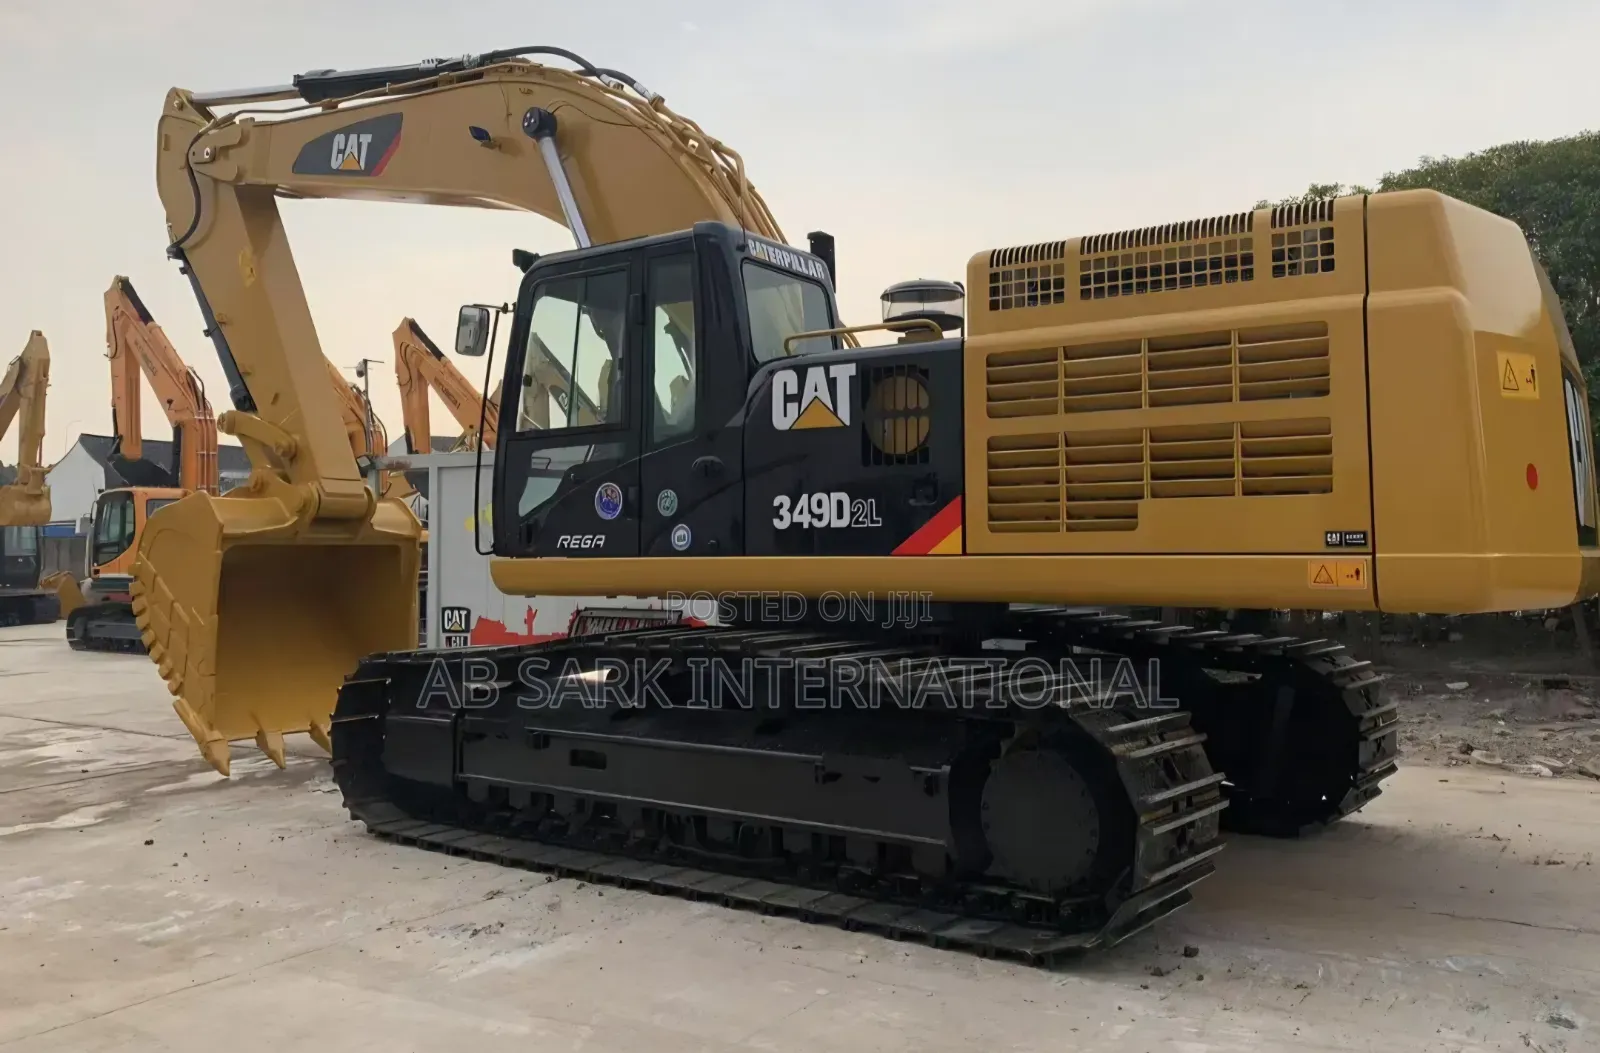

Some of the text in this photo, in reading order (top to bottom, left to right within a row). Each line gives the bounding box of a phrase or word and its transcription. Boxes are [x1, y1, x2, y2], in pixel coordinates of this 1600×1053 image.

[330, 133, 373, 171] CAT
[747, 238, 825, 280] CATERPILLAR
[771, 362, 857, 431] CAT
[556, 534, 606, 549] REGA
[444, 609, 468, 631] CAT
